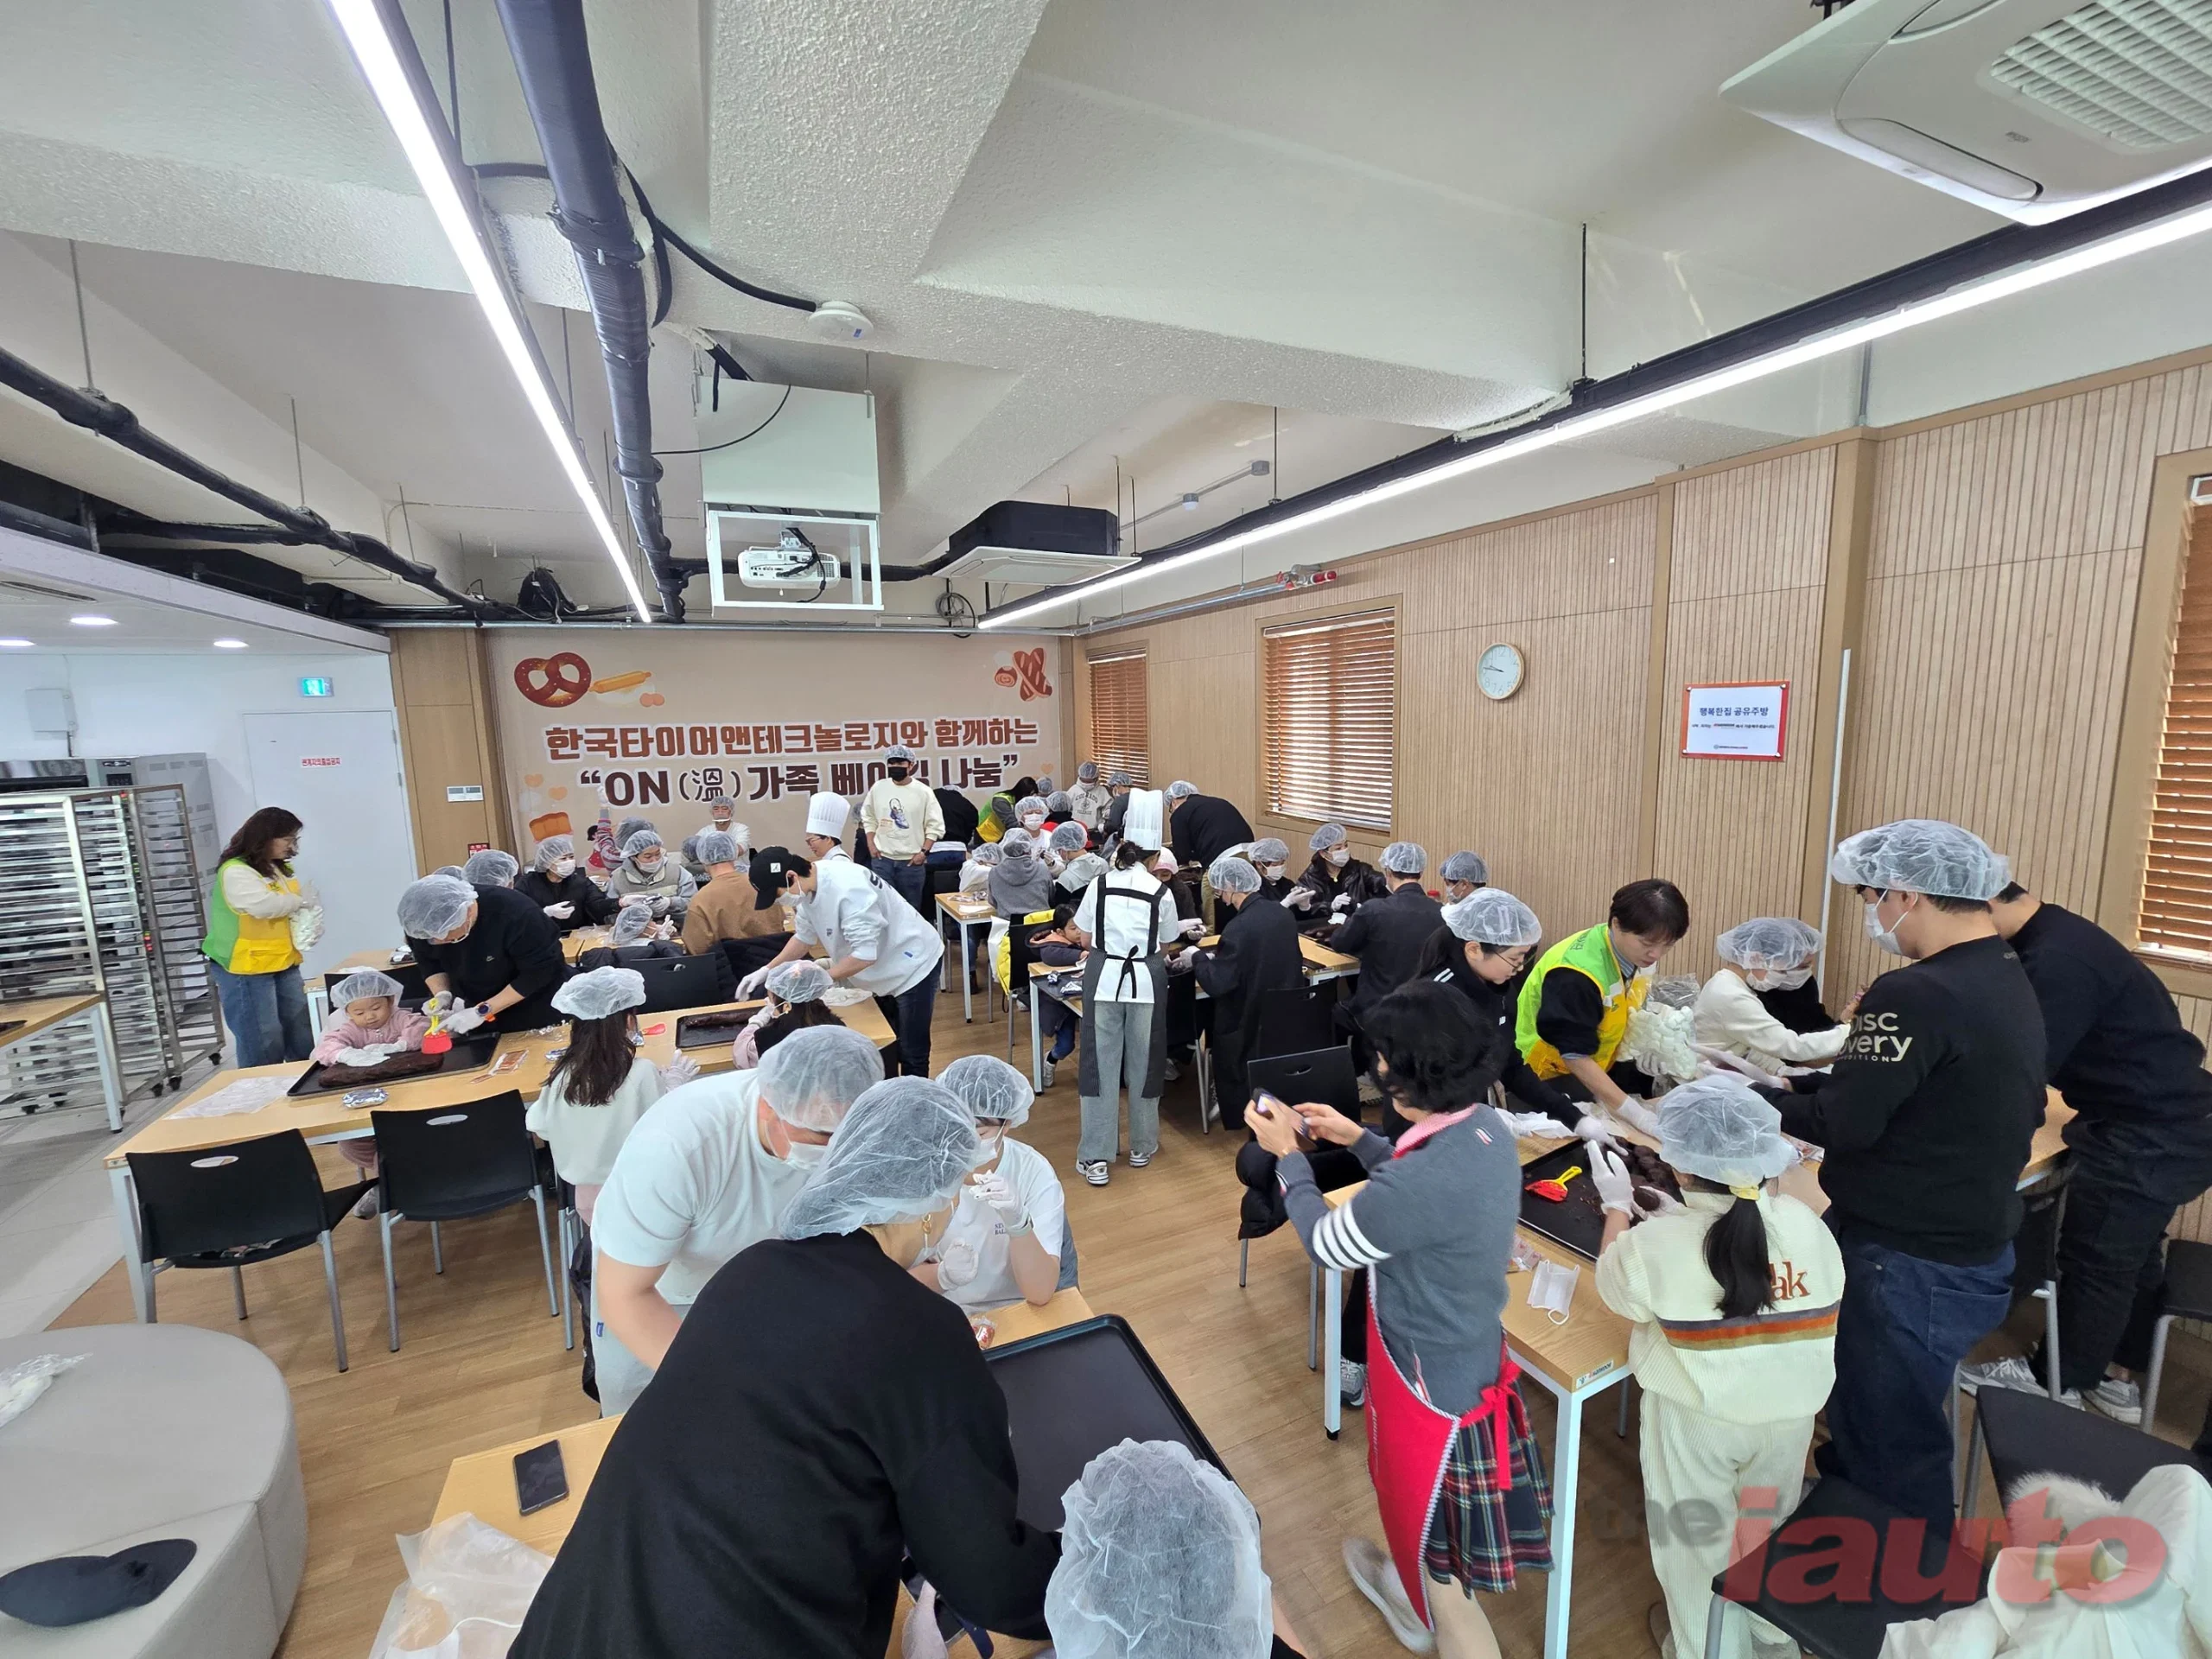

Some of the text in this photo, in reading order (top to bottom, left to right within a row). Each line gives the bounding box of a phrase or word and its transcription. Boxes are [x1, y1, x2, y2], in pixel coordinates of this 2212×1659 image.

[1734, 707, 1769, 716] 공유주방
[545, 718, 1038, 760] 한국타이어앤테크놀로지와 함께하는
[747, 765, 819, 801] 가족
